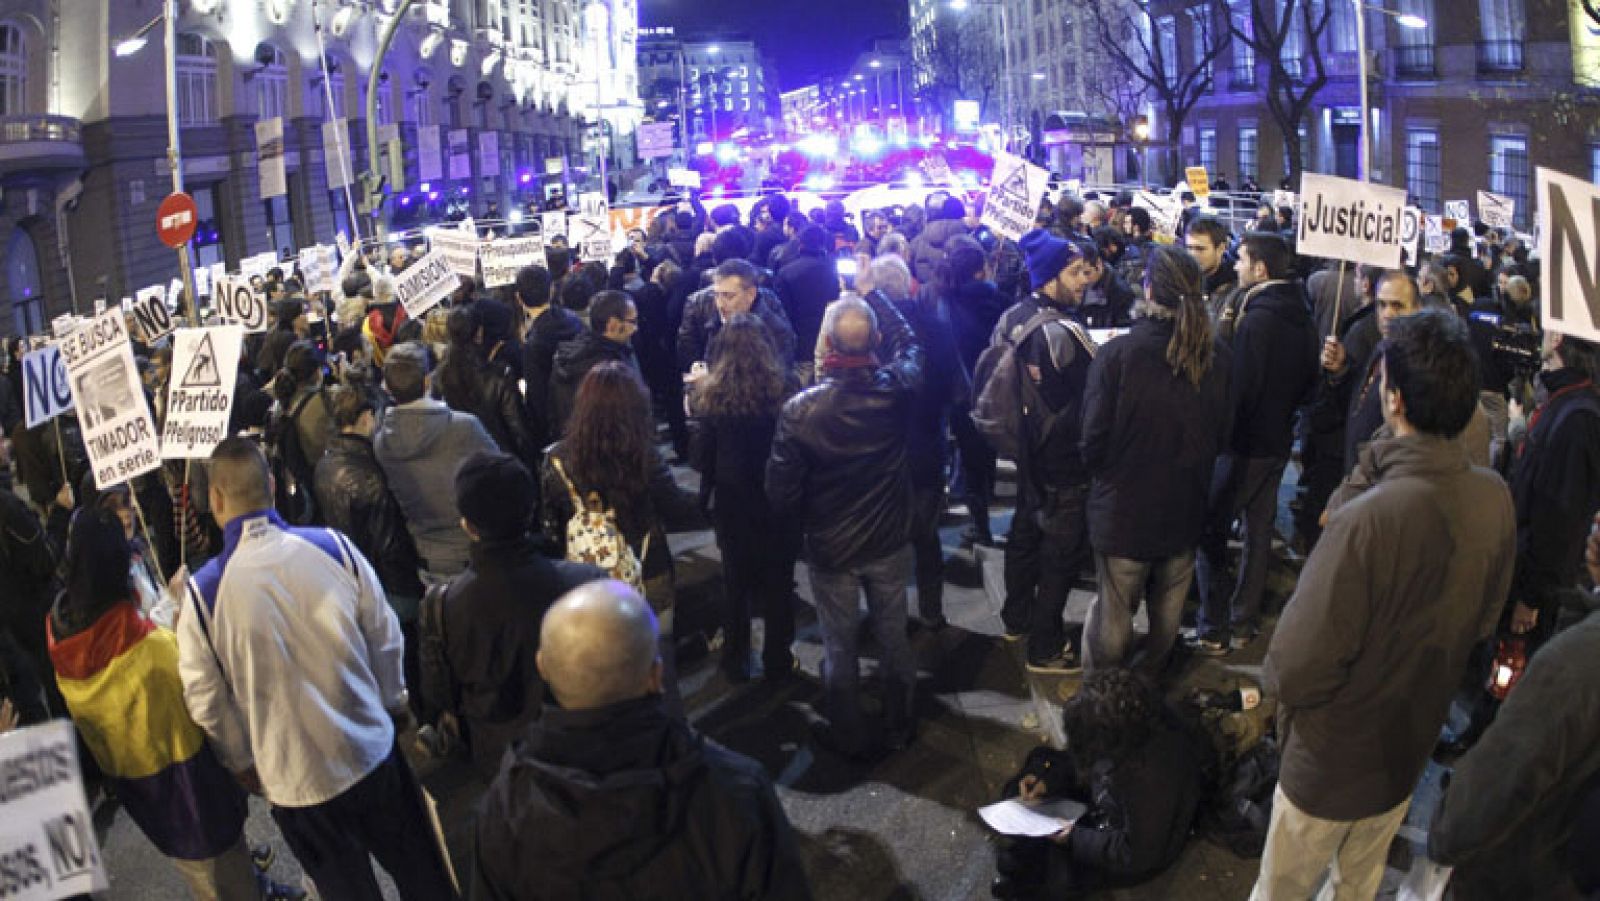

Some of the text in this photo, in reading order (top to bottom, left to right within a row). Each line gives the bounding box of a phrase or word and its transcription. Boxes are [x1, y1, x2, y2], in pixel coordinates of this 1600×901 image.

[1301, 193, 1401, 247] ¡Justicia!
[62, 316, 123, 363] SE BUSCA
[171, 388, 228, 413] PPartido
[88, 416, 151, 461] TIMADOR
[99, 466, 117, 484] en
